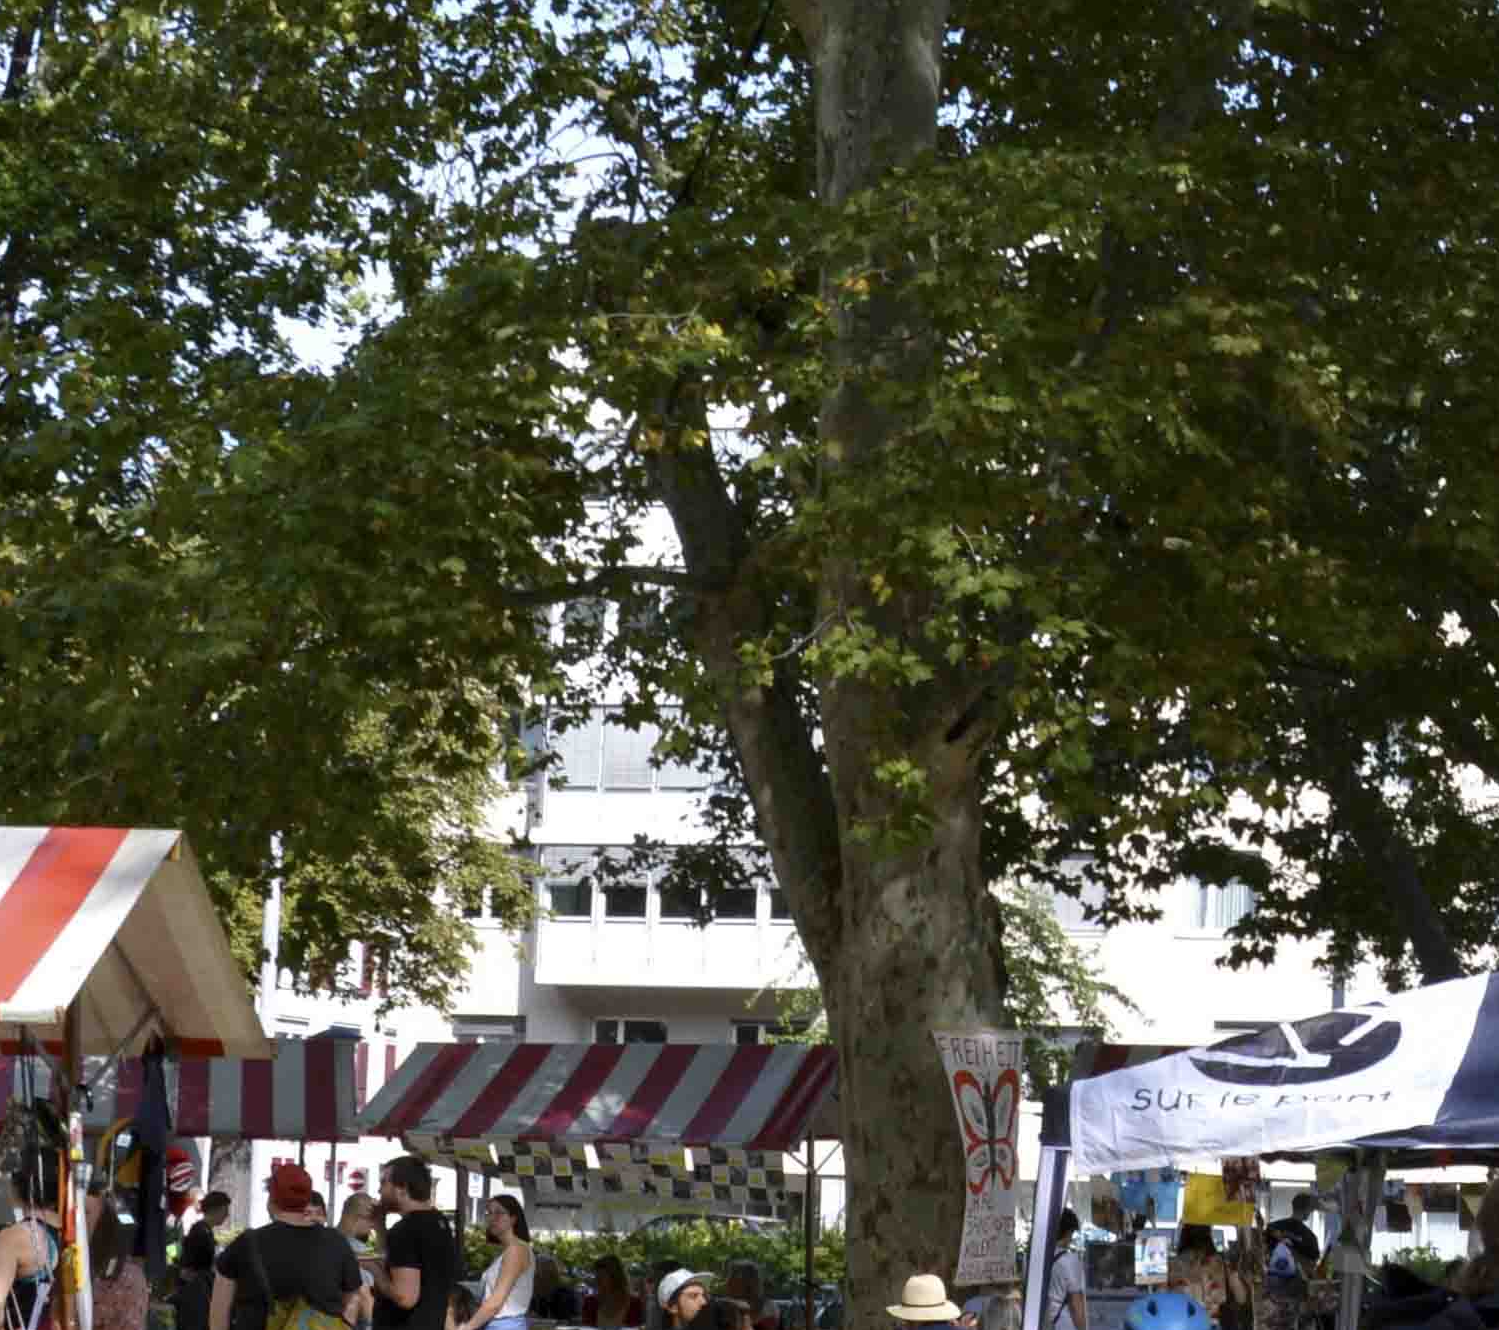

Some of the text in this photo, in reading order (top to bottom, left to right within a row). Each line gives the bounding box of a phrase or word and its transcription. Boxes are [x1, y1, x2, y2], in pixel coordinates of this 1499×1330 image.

[937, 1037, 1020, 1070] FREIHEIT
[1130, 1087, 1201, 1112] sur
[1219, 1091, 1261, 1109] le
